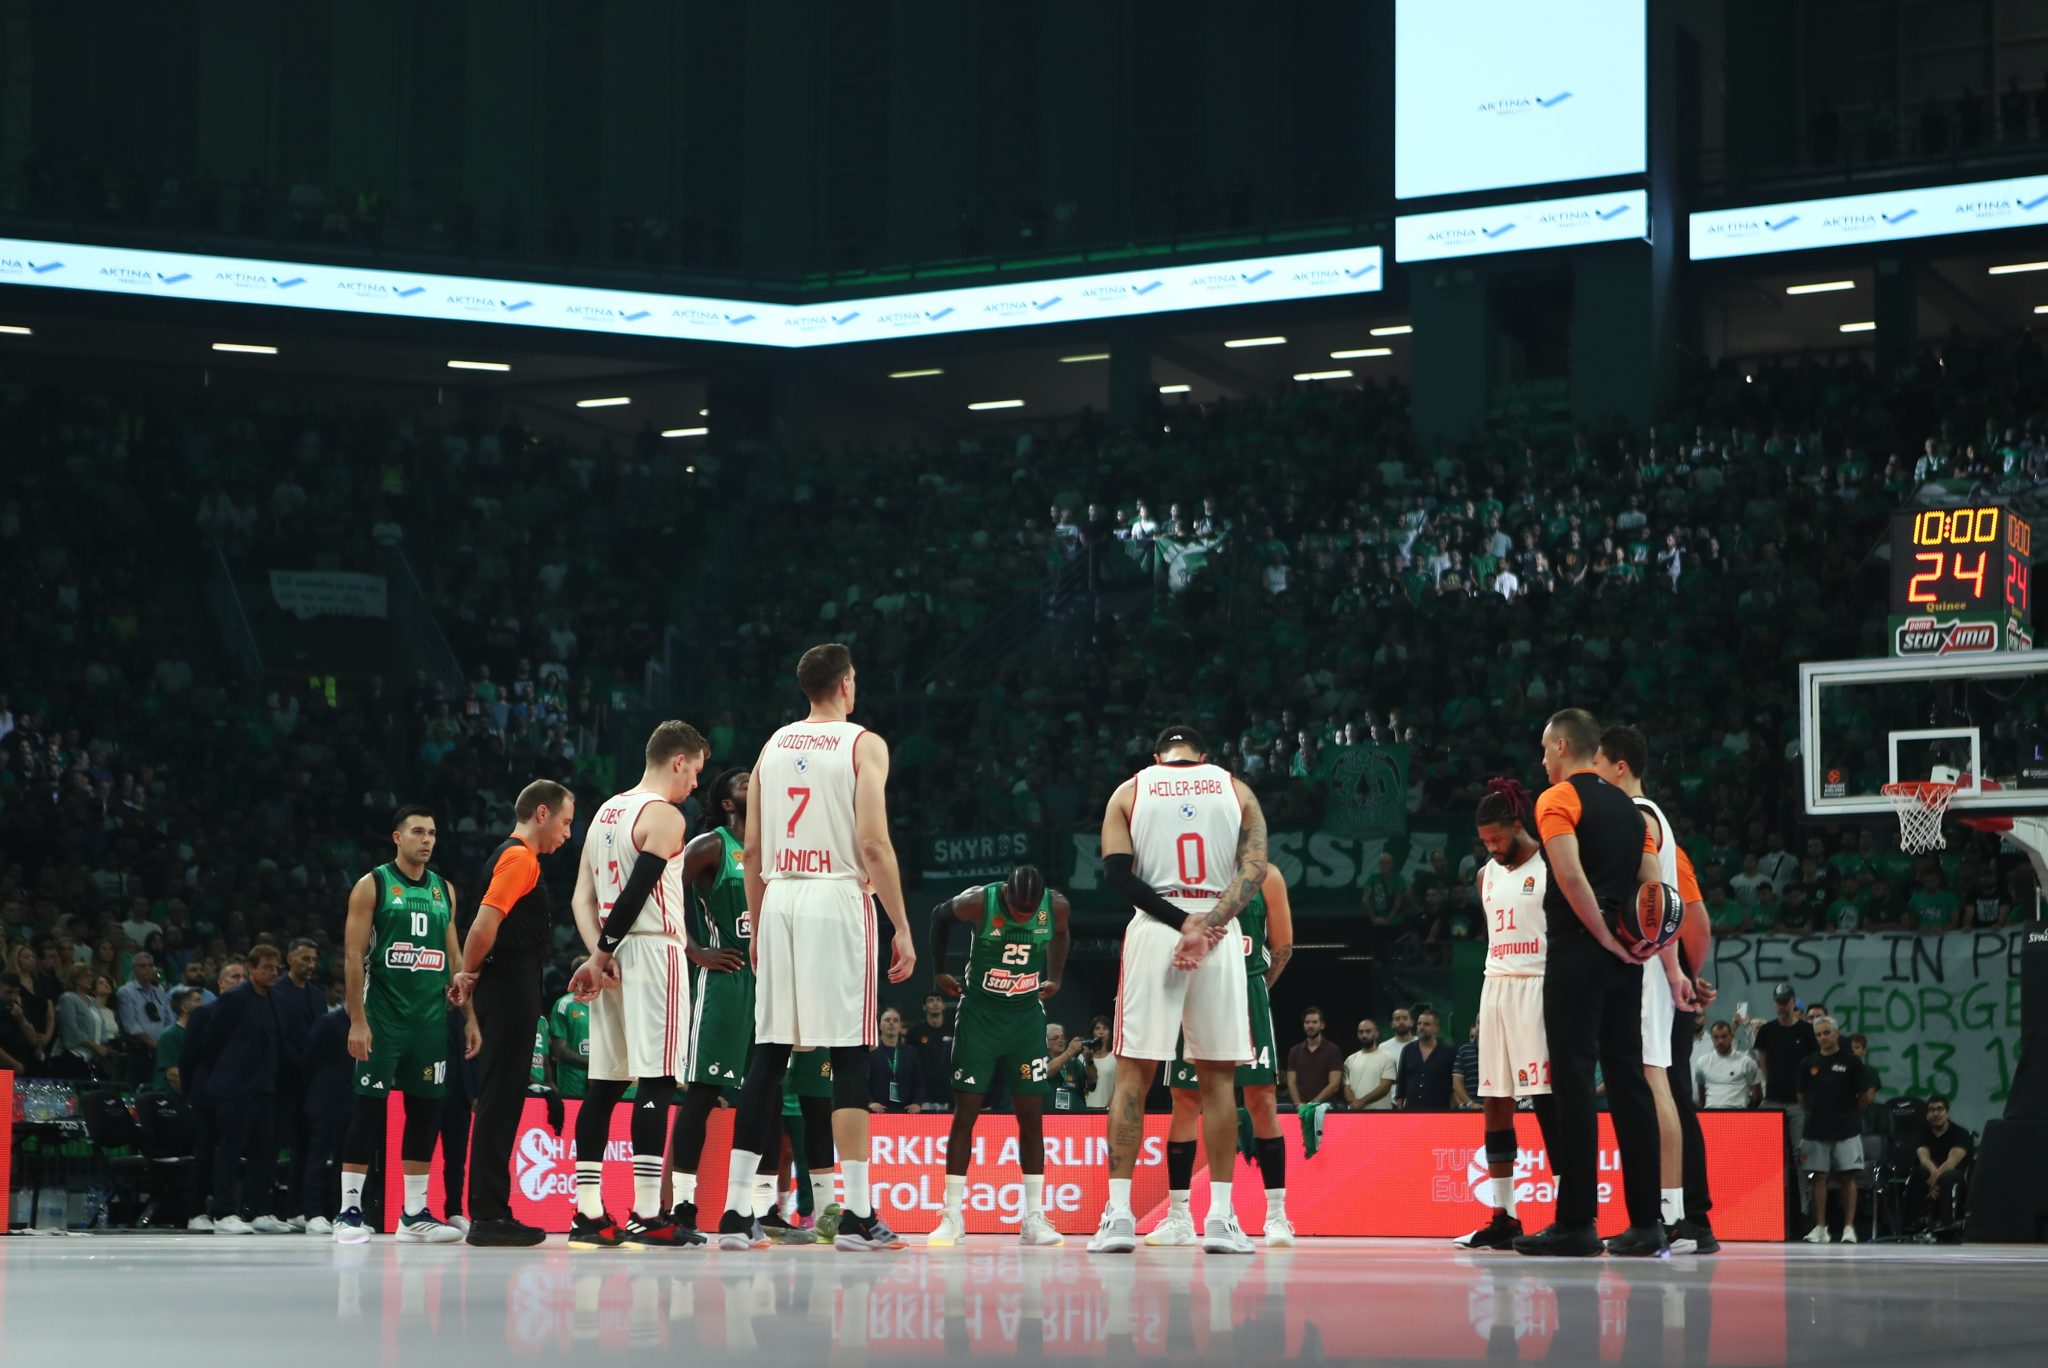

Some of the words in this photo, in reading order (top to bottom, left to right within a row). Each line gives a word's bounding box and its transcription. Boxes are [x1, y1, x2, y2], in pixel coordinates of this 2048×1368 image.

[1478, 99, 1530, 112] AKTINA
[1955, 200, 2010, 214] AKTINA
[1540, 211, 1590, 224] AKTINA
[1823, 214, 1876, 228] AKTINA
[1427, 229, 1476, 241] AKTINA
[1707, 221, 1759, 234] AKTINA
[99, 268, 152, 280] AKTINA
[216, 272, 266, 284] AKTINA
[1191, 274, 1236, 286] AKTINA
[1292, 269, 1339, 281] AKTINA
[1913, 507, 1998, 545] 10:00
[1908, 551, 1986, 602] 24
[2006, 553, 2028, 609] 24
[777, 734, 841, 751] VOIGTMANN
[1149, 779, 1223, 797] WEILER-BABB
[787, 787, 810, 838] 7
[410, 911, 428, 937] 10
[1495, 908, 1516, 933] 31
[1002, 943, 1031, 965] 25
[1490, 937, 1540, 960] iegmund
[1713, 933, 1865, 989] REST
[1881, 934, 1945, 984] IN
[433, 1060, 447, 1085] 10
[1528, 1062, 1552, 1086] 31
